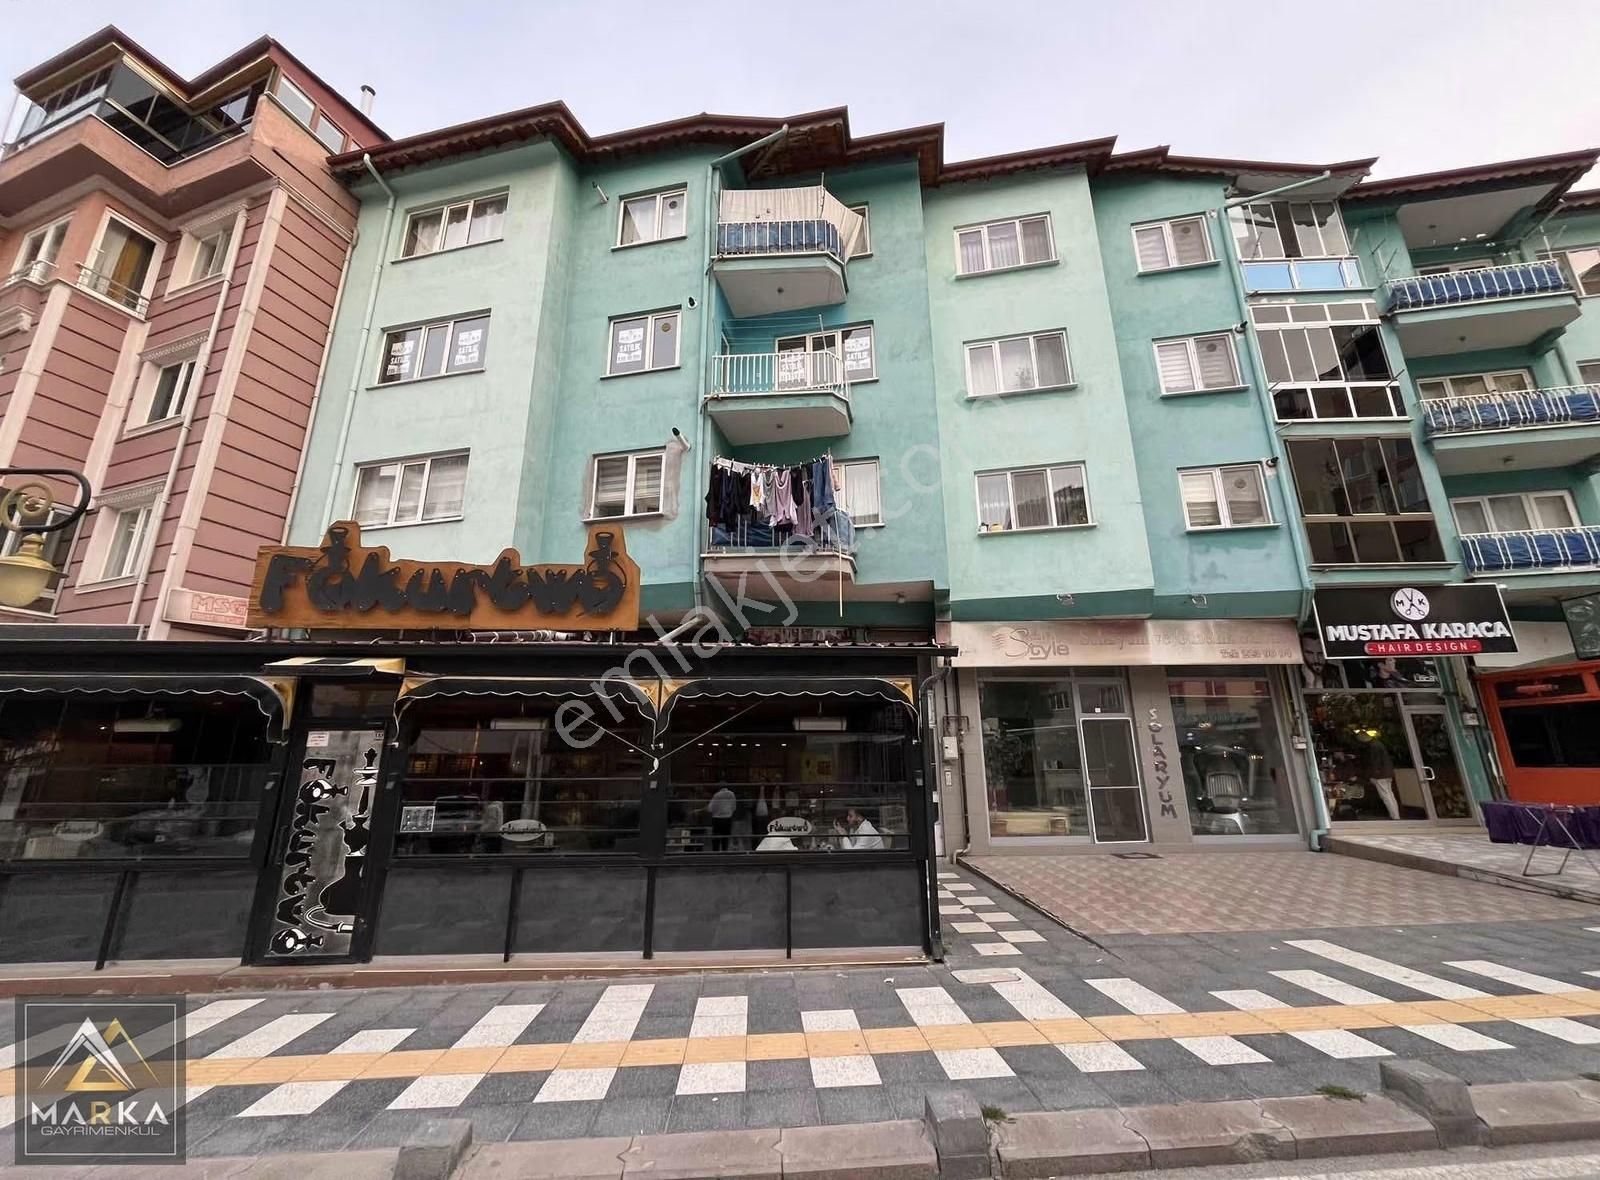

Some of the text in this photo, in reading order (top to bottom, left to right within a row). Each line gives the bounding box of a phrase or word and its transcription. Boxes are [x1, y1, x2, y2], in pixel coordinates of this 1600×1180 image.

[1325, 621, 1511, 642] MUSTAFA KARACA
[1377, 641, 1469, 653] HAIR DESIGN
[1148, 708, 1178, 819] SOLARYUM
